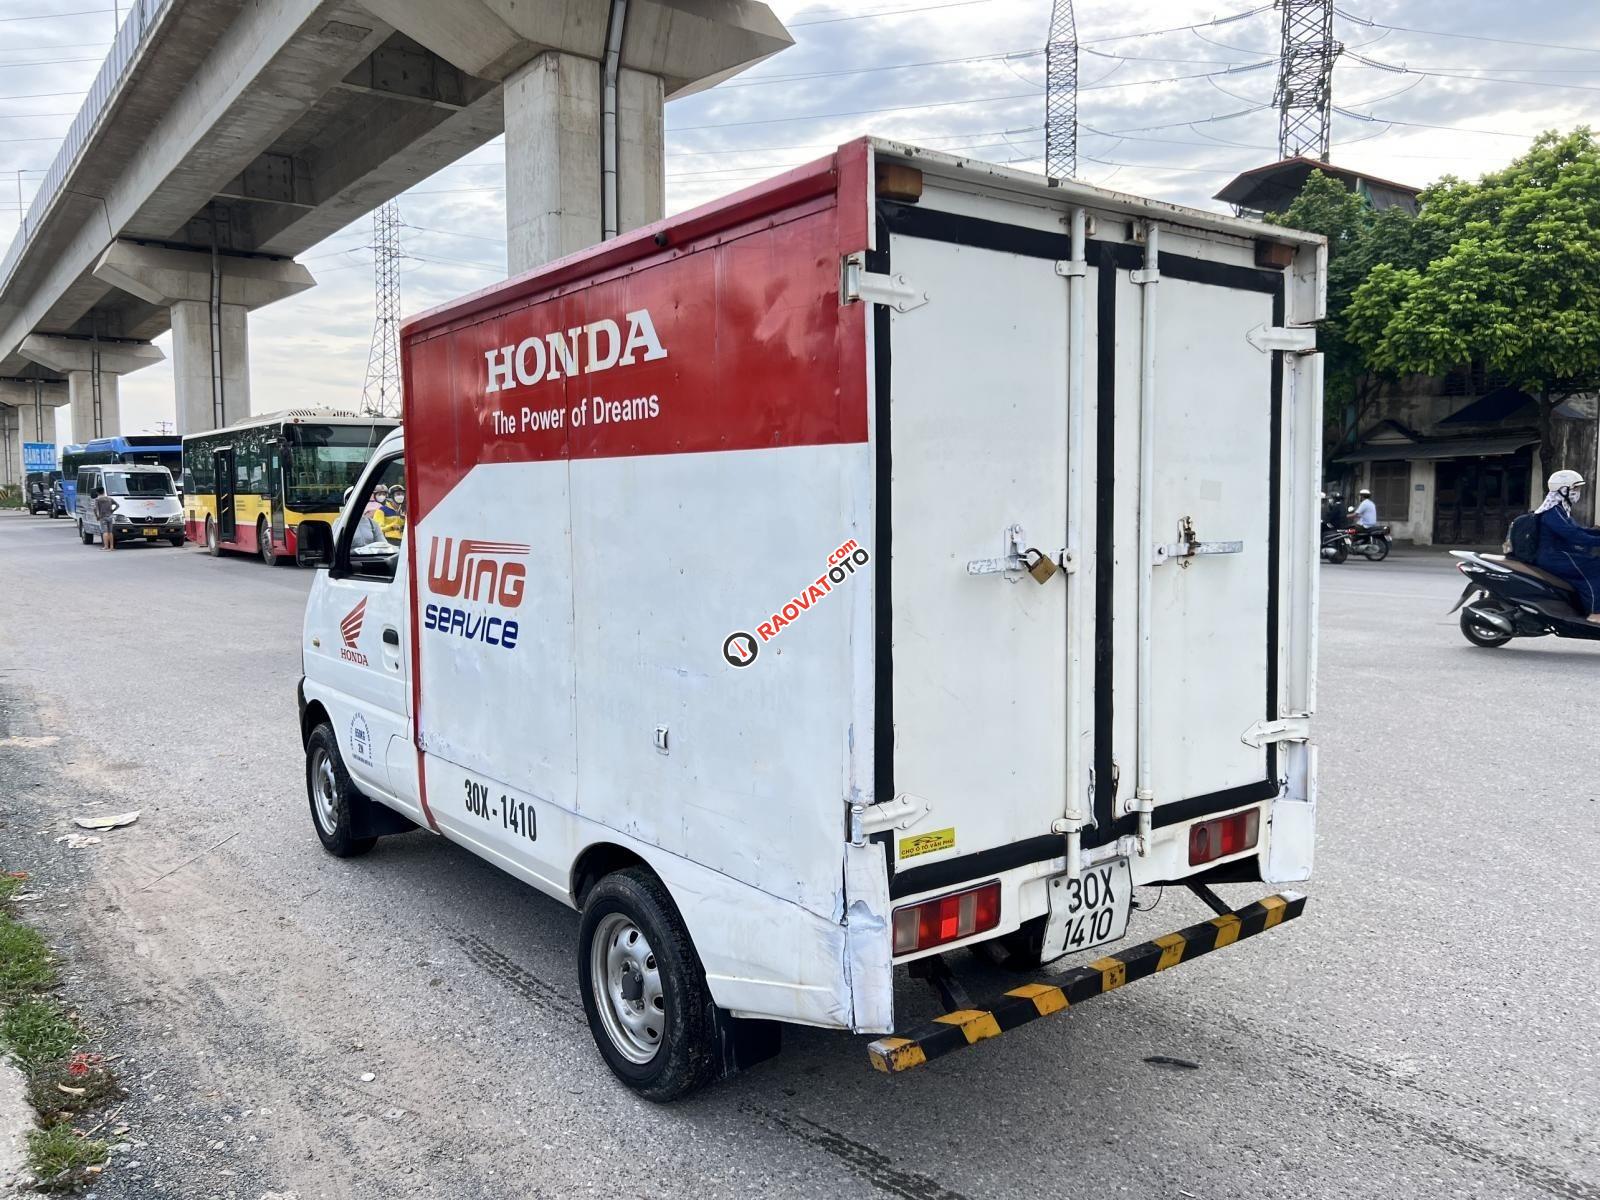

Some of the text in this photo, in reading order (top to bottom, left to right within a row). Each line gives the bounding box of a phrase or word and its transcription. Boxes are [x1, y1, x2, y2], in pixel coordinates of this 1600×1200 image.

[485, 308, 667, 393] HONDA
[493, 394, 660, 435] The Power of Dreams
[340, 648, 369, 666] HONDA
[1067, 866, 1114, 913] 30X
[1062, 907, 1113, 951] 1410
